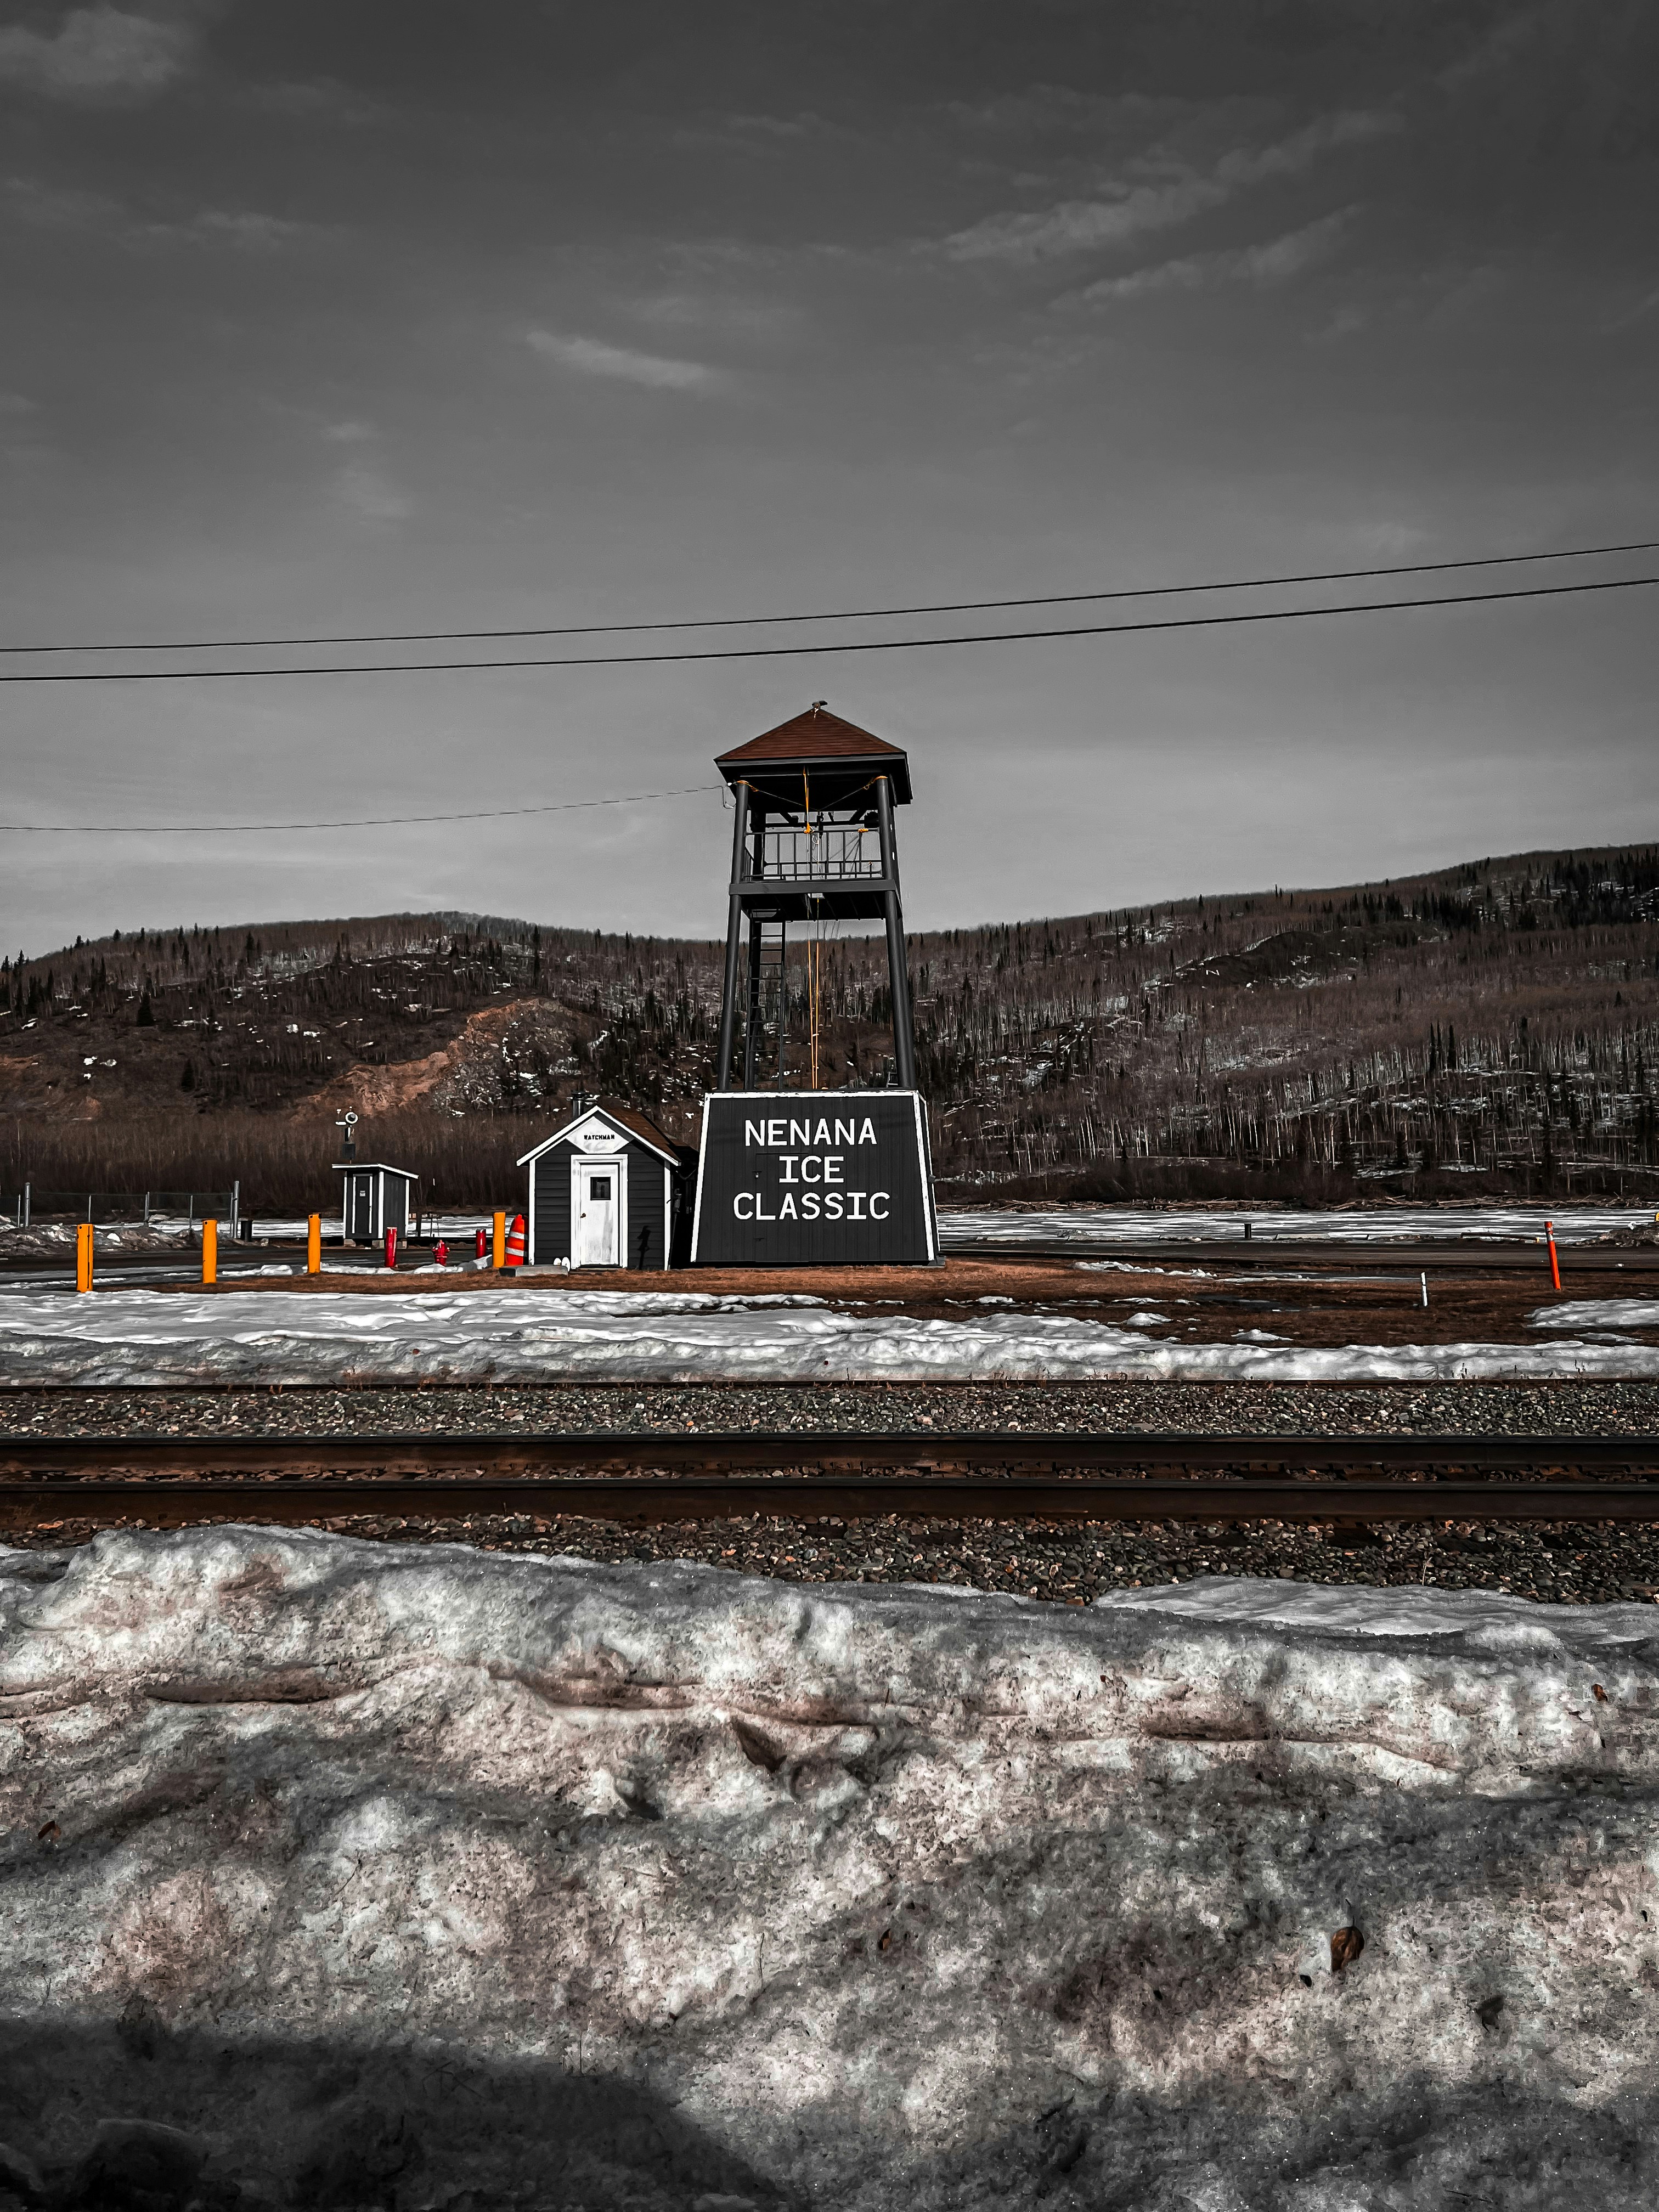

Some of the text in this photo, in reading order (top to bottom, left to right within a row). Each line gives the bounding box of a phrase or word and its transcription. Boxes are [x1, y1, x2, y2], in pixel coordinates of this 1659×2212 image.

[745, 1118, 877, 1146] NENANA
[778, 1155, 844, 1183] ICE
[733, 1192, 890, 1220] CLASSIC
